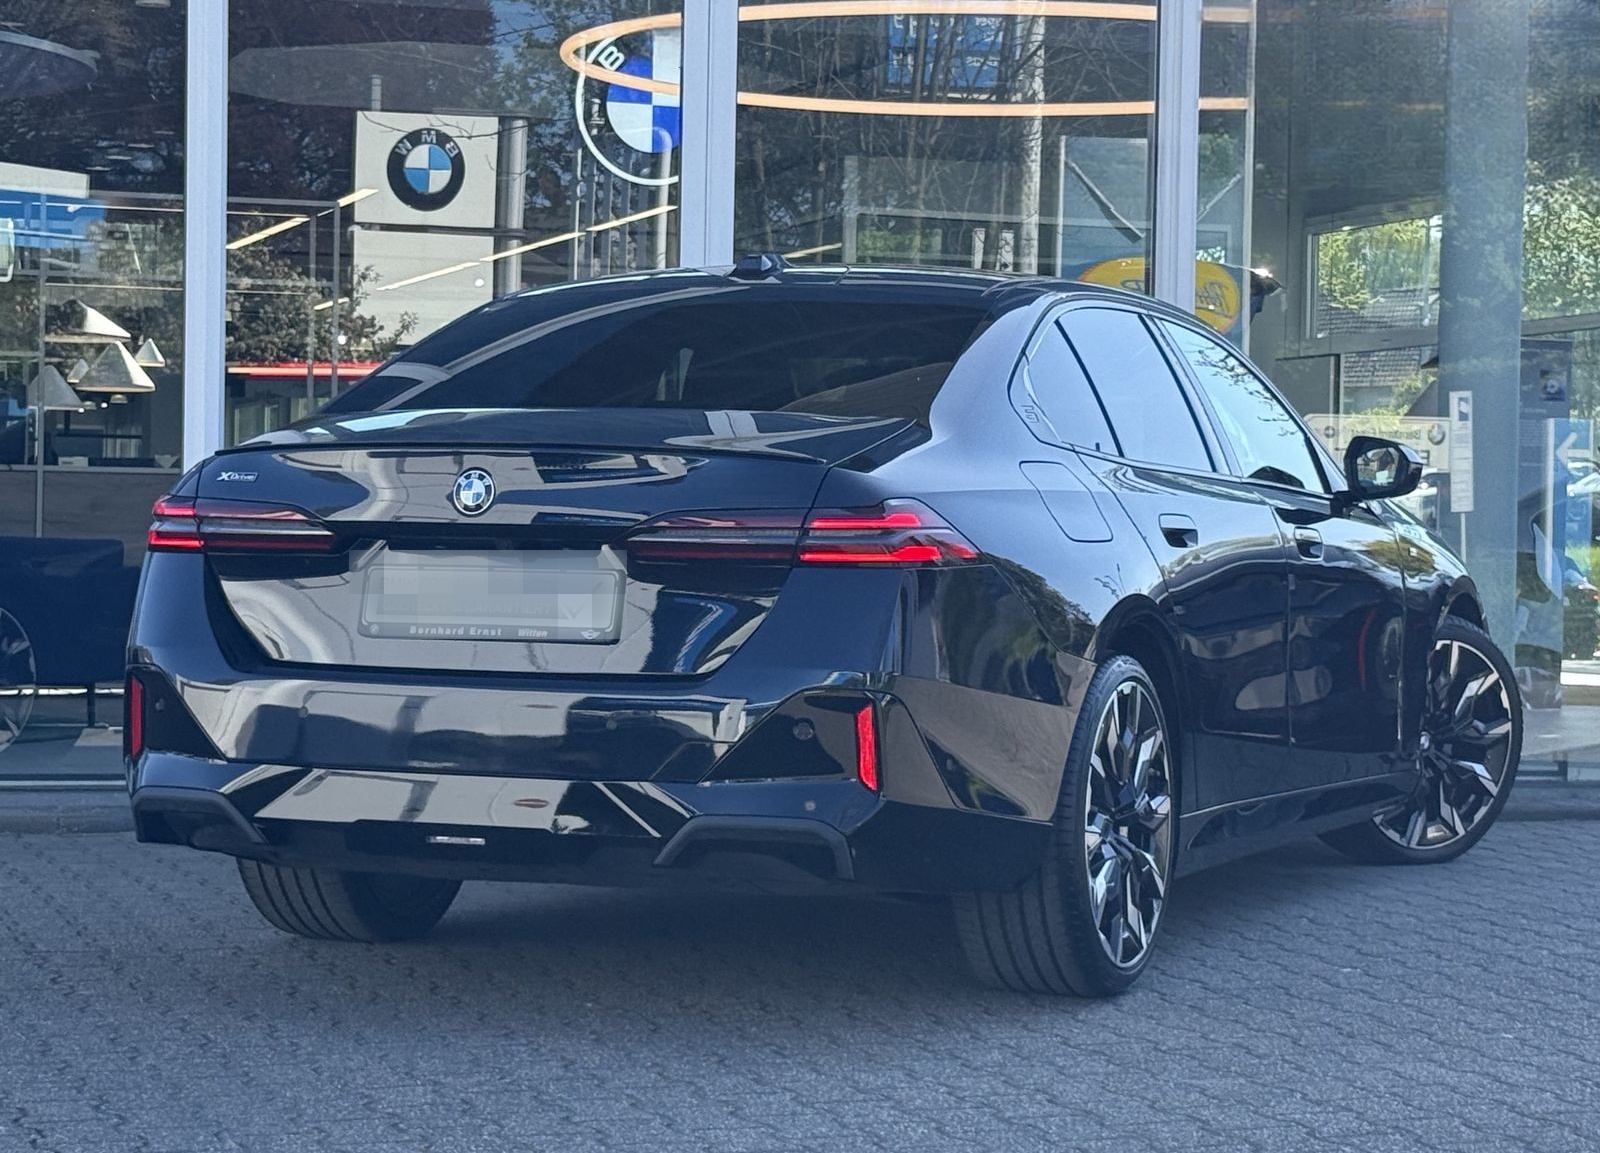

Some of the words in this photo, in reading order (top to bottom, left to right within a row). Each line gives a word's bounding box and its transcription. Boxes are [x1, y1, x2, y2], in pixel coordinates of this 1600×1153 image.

[409, 625, 465, 636] Bernhard
[469, 627, 502, 637] Ernst
[518, 628, 548, 638] Witten
